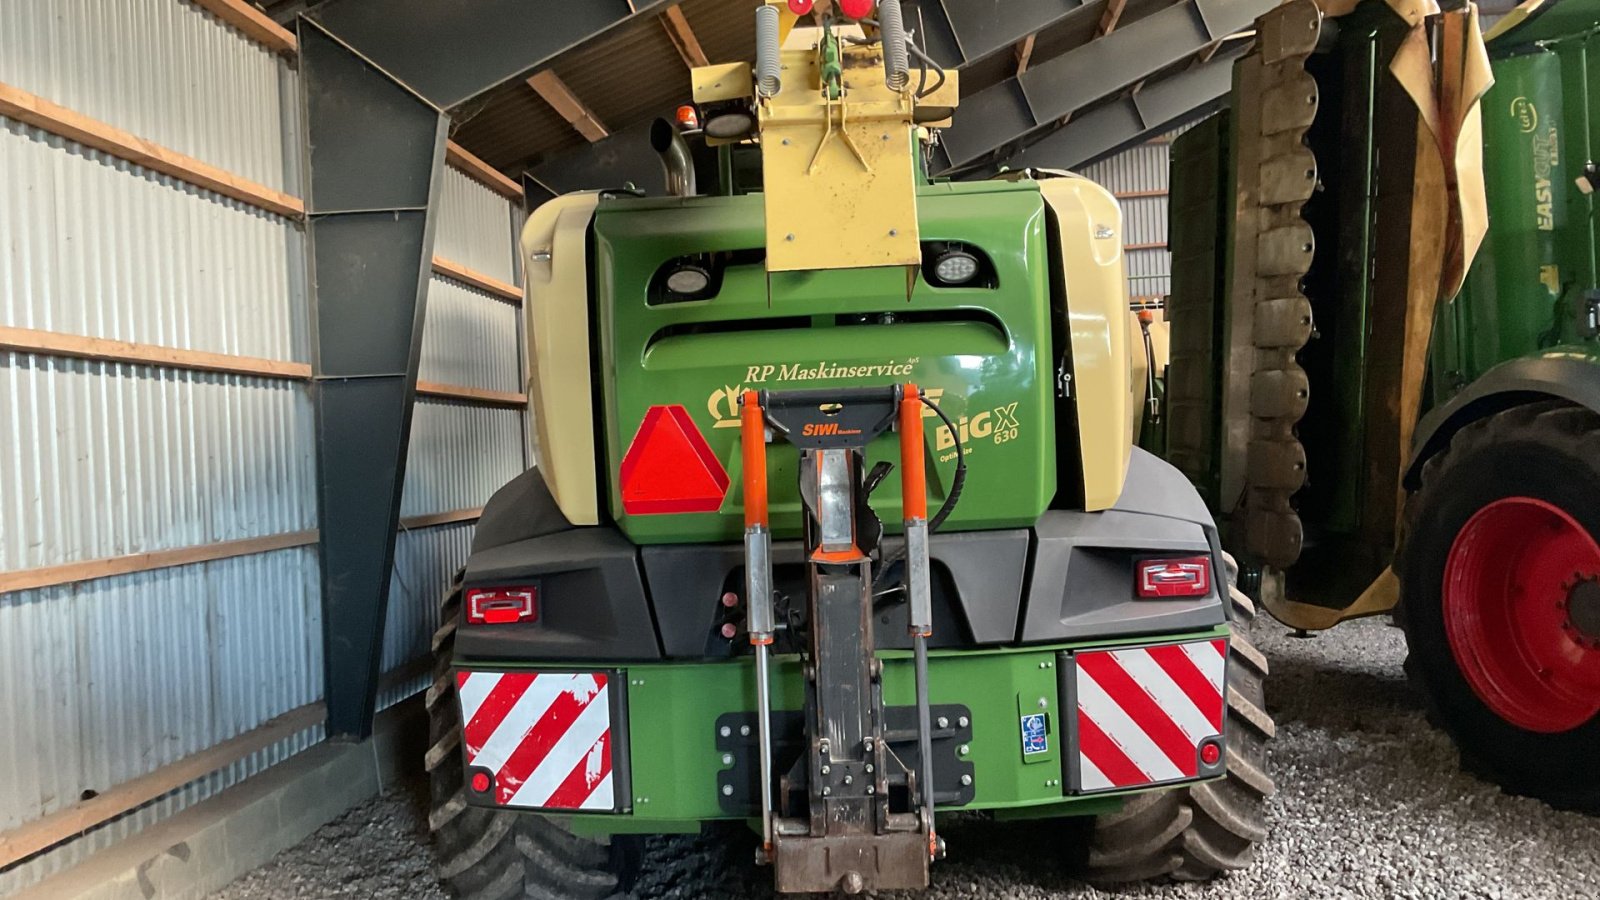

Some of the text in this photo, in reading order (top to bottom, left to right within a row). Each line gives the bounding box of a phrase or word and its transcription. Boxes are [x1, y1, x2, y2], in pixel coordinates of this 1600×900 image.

[744, 365, 775, 383] RP
[776, 360, 914, 381] Maskinservice
[993, 401, 1020, 433] X
[802, 422, 839, 436] SIWI
[993, 427, 1018, 445] 630
